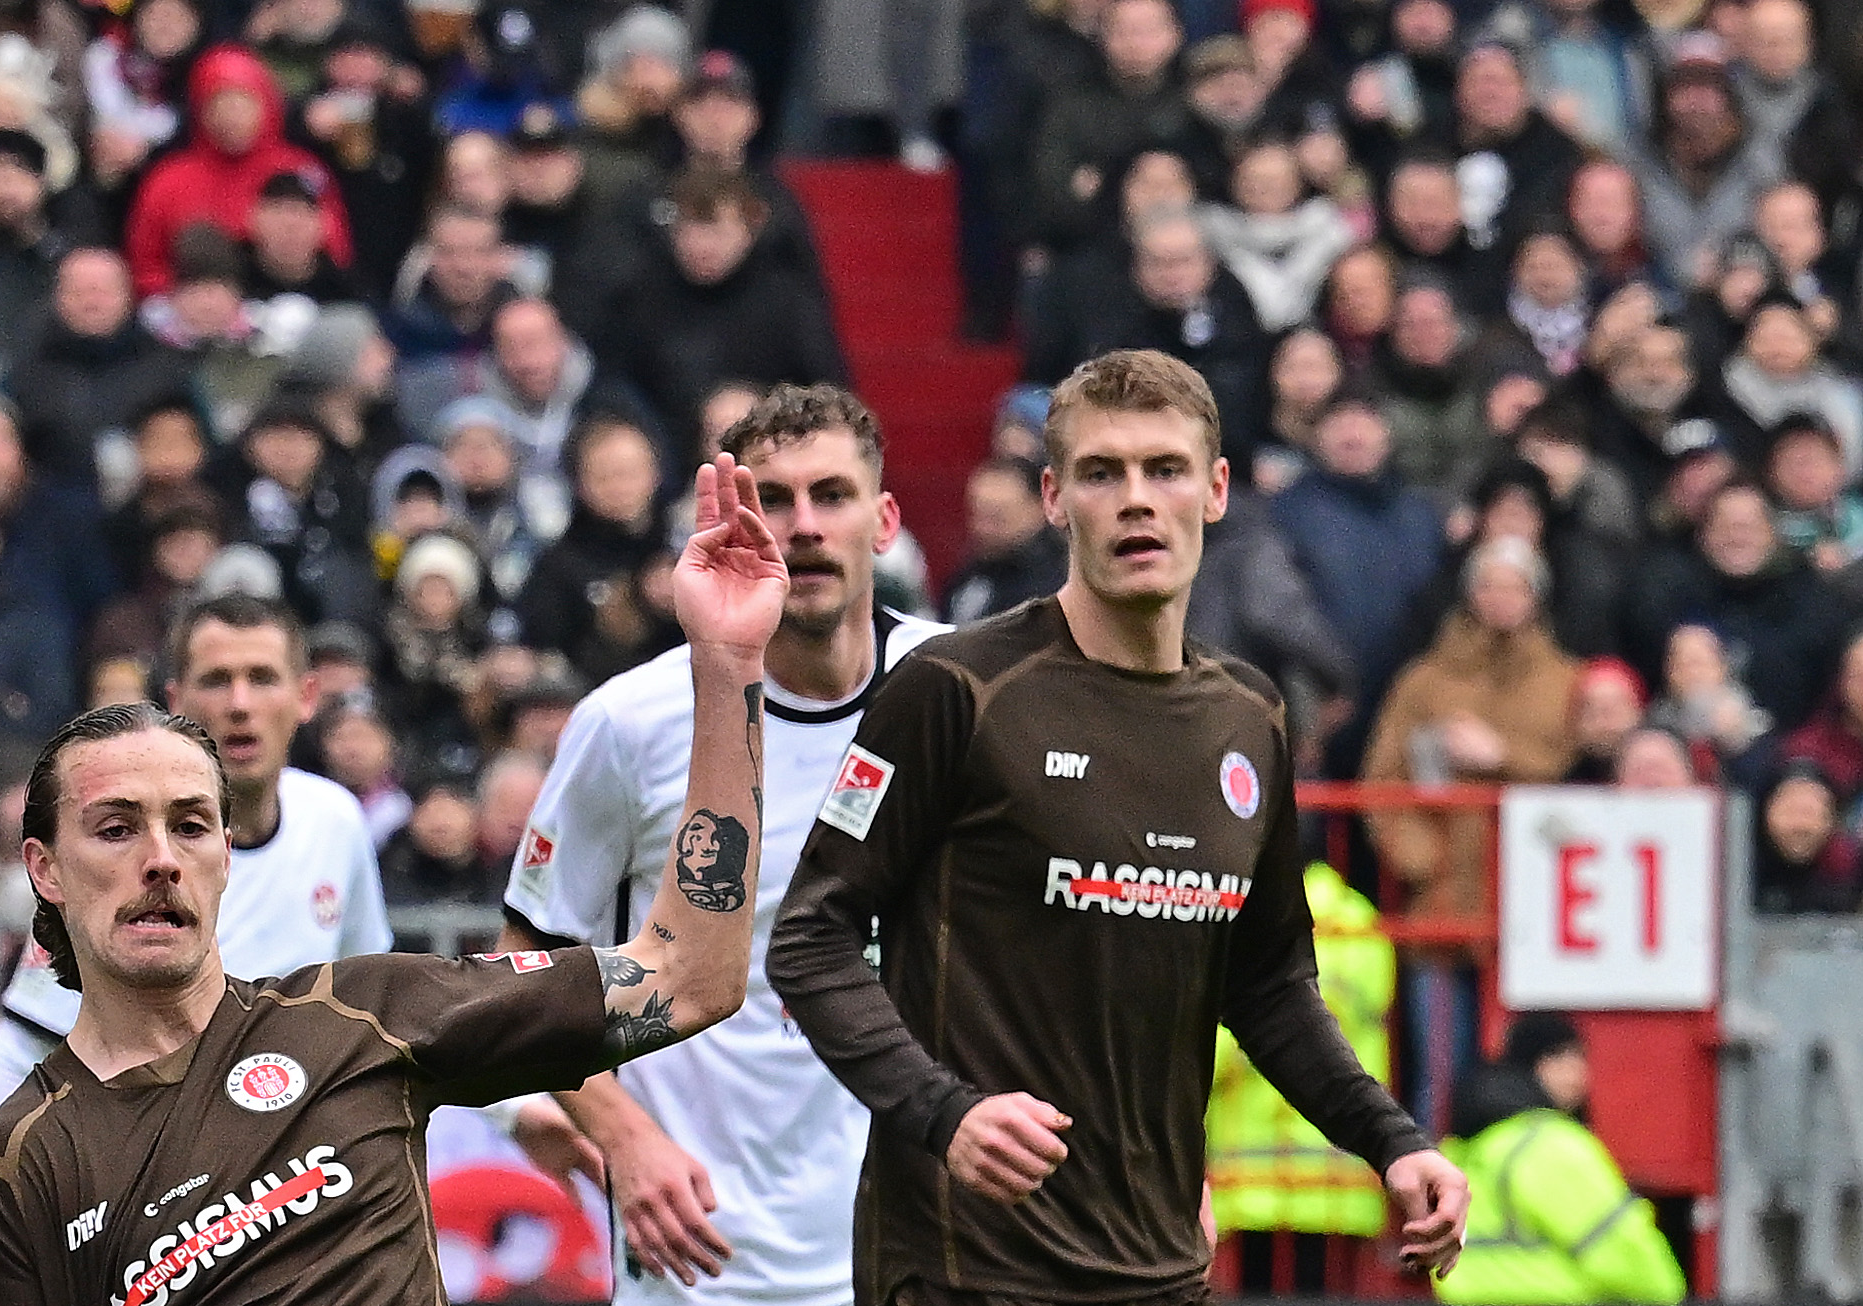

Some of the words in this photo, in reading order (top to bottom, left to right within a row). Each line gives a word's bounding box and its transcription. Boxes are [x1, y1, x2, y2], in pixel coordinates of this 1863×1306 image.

[253, 1056, 296, 1071] PAULI
[265, 1092, 293, 1109] 1910
[159, 1174, 210, 1206] congstar
[136, 1260, 177, 1297] KEIN
[174, 1222, 231, 1266] PLATZ
